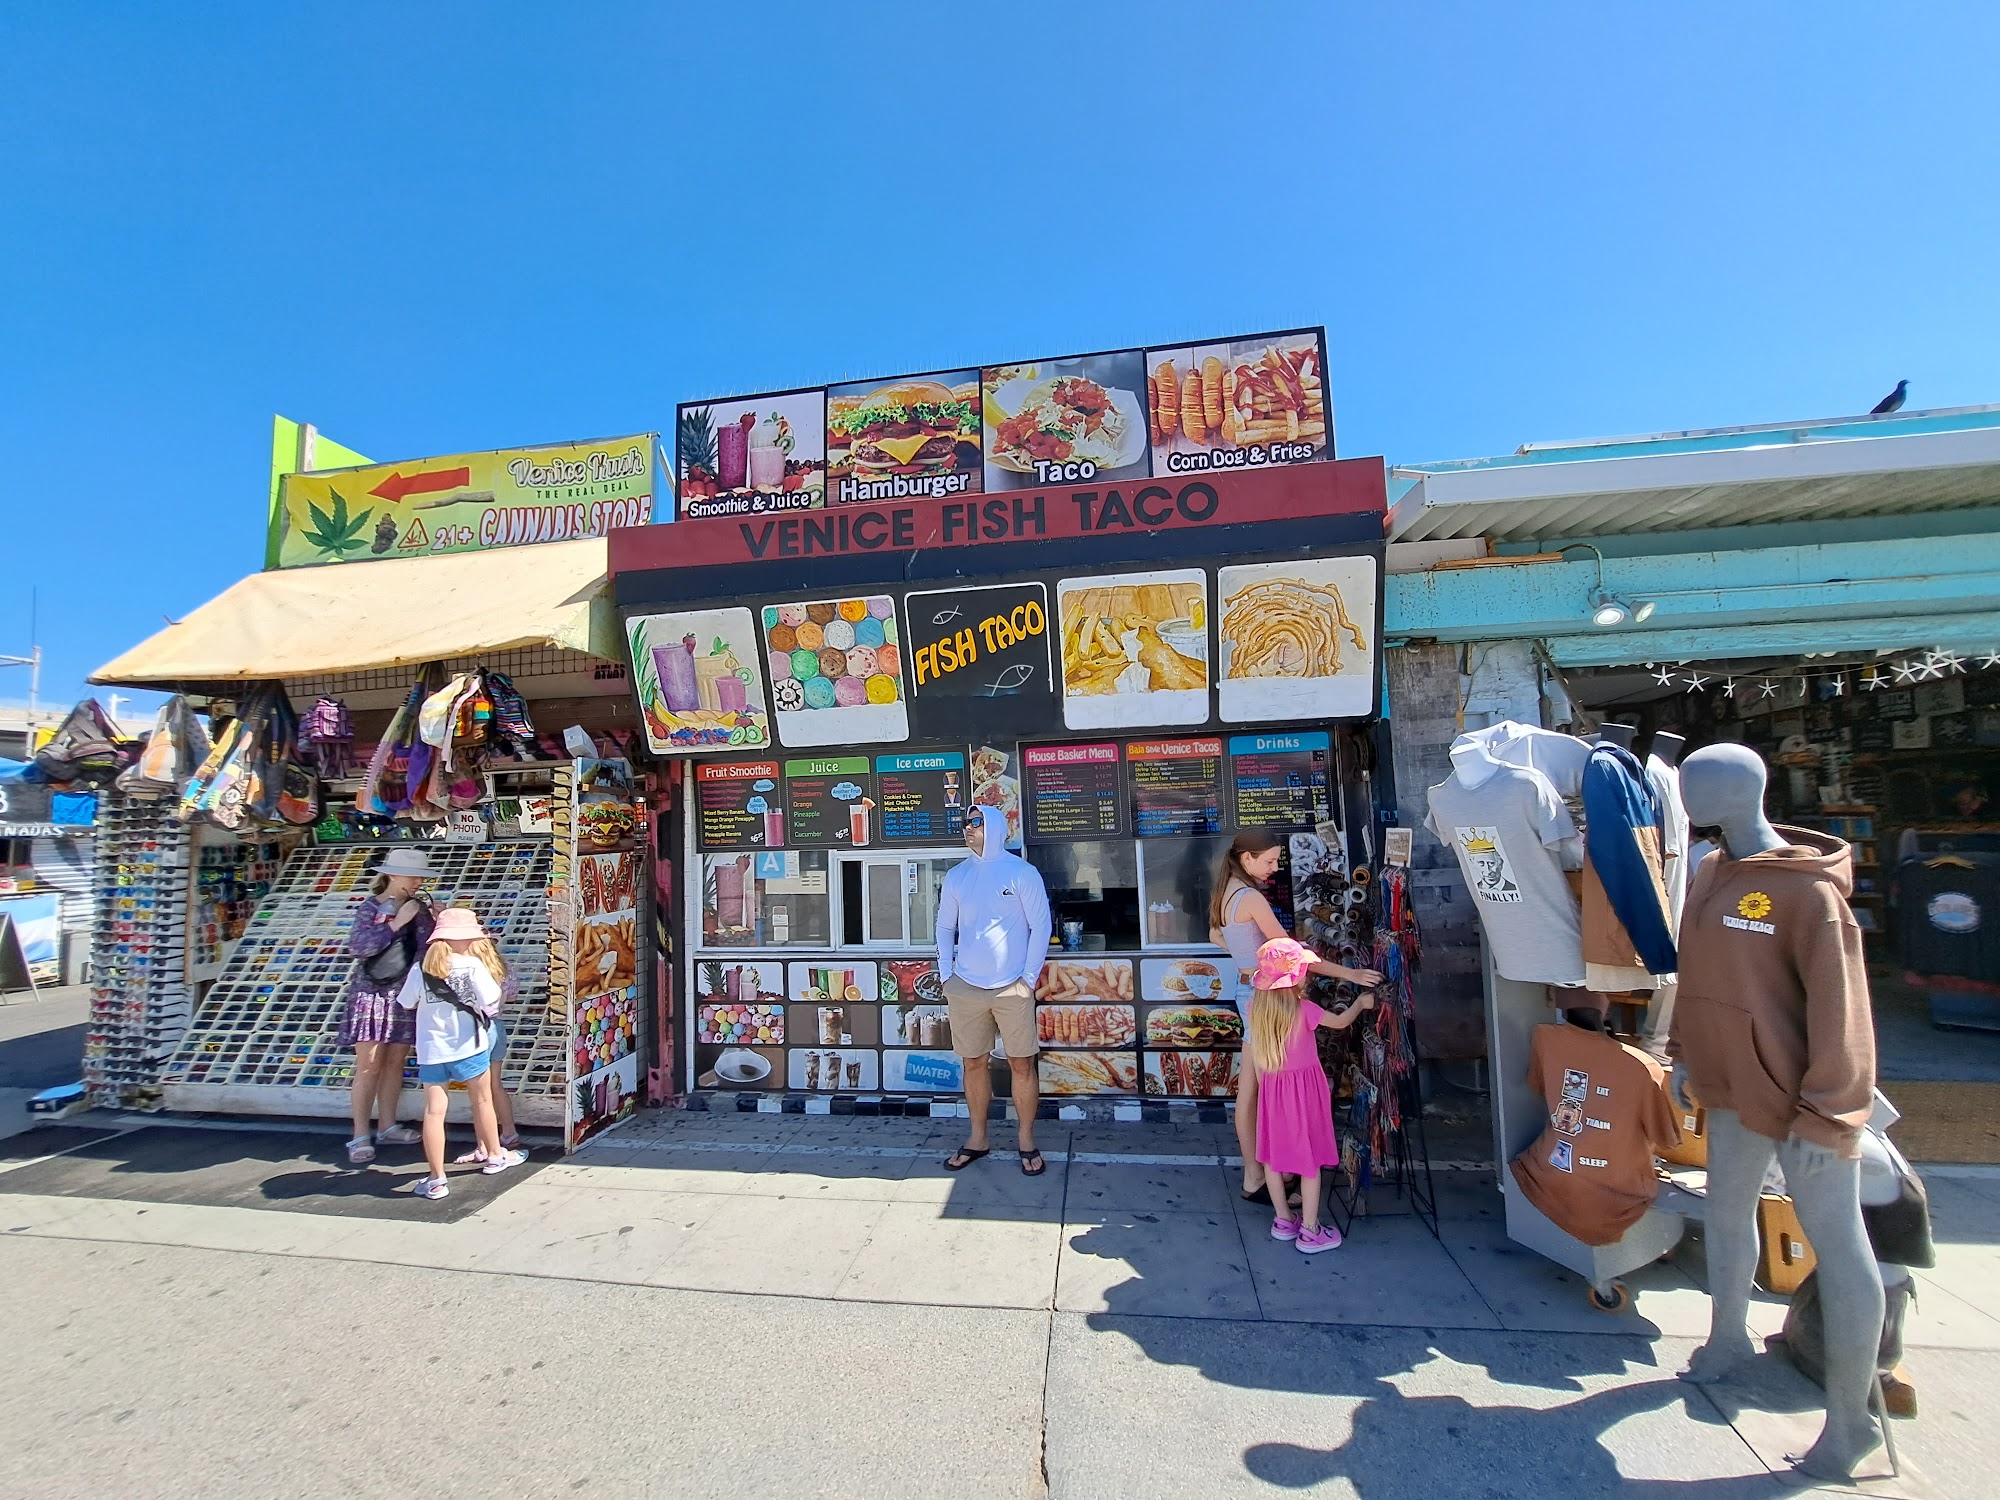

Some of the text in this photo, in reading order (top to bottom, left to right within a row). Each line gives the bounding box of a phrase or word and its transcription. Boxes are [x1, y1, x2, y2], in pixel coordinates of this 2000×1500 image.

[1169, 442, 1313, 472] Corn Dog & Fries
[509, 446, 646, 488] Venice Kush
[1034, 459, 1096, 483] Taco
[536, 483, 630, 499] THE REAL DEAL
[839, 472, 969, 502] Hamburger
[689, 493, 809, 517] Smoothie & Juice
[430, 495, 652, 550] 21+ CANNABIS STORE
[740, 482, 1218, 558] VENICE FISH TACO
[915, 600, 1045, 686] FISH TACO
[1128, 745, 1145, 754] Baja
[1161, 743, 1191, 754] Venice
[1193, 741, 1219, 753] Tacos
[1256, 736, 1300, 749] Drinks
[1028, 747, 1114, 762] House Basket Menu
[810, 762, 839, 773] Juice
[896, 758, 945, 768] Ice cream
[706, 765, 772, 778] Fruit Smoothie
[461, 814, 474, 823] NO
[0, 825, 65, 838] NADAS
[453, 824, 481, 833] PHOTO
[762, 852, 780, 872] A
[1480, 890, 1520, 902] FINALLY!
[912, 1065, 951, 1080] WATER
[1578, 1156, 1608, 1168] SLEEP
